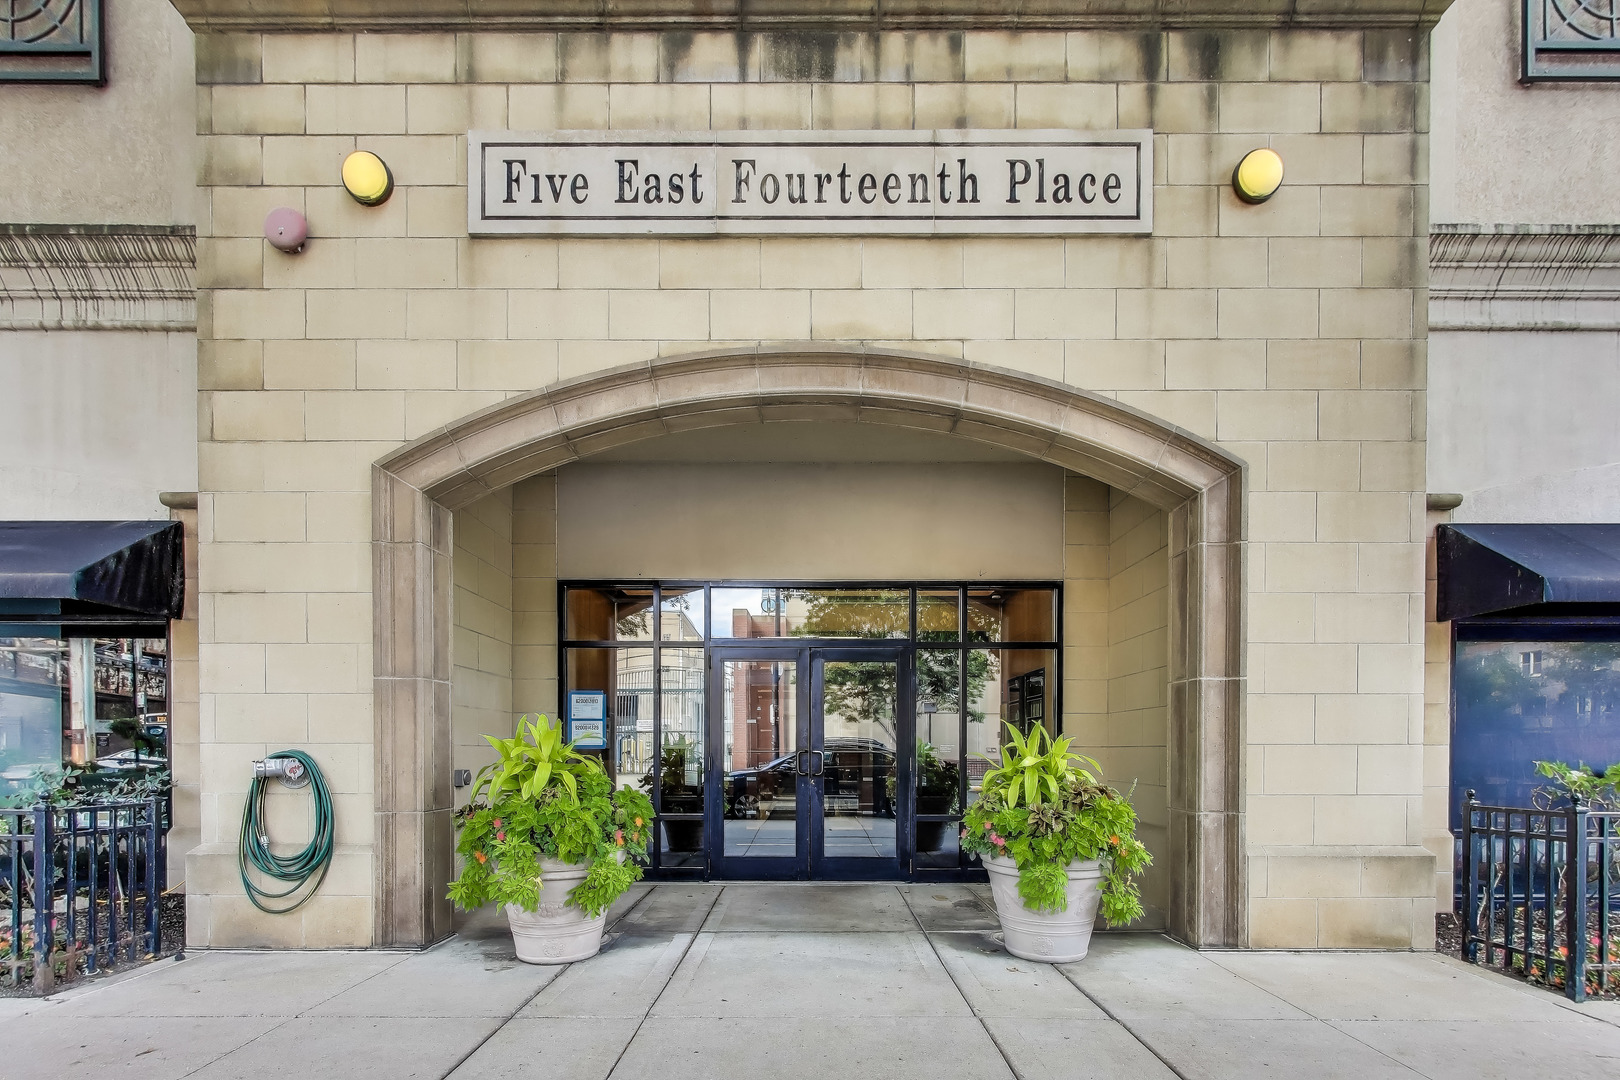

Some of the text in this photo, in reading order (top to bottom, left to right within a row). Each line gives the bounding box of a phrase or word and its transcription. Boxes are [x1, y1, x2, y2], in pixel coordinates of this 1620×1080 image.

[501, 158, 1123, 205] Five East Fourteenth Place
